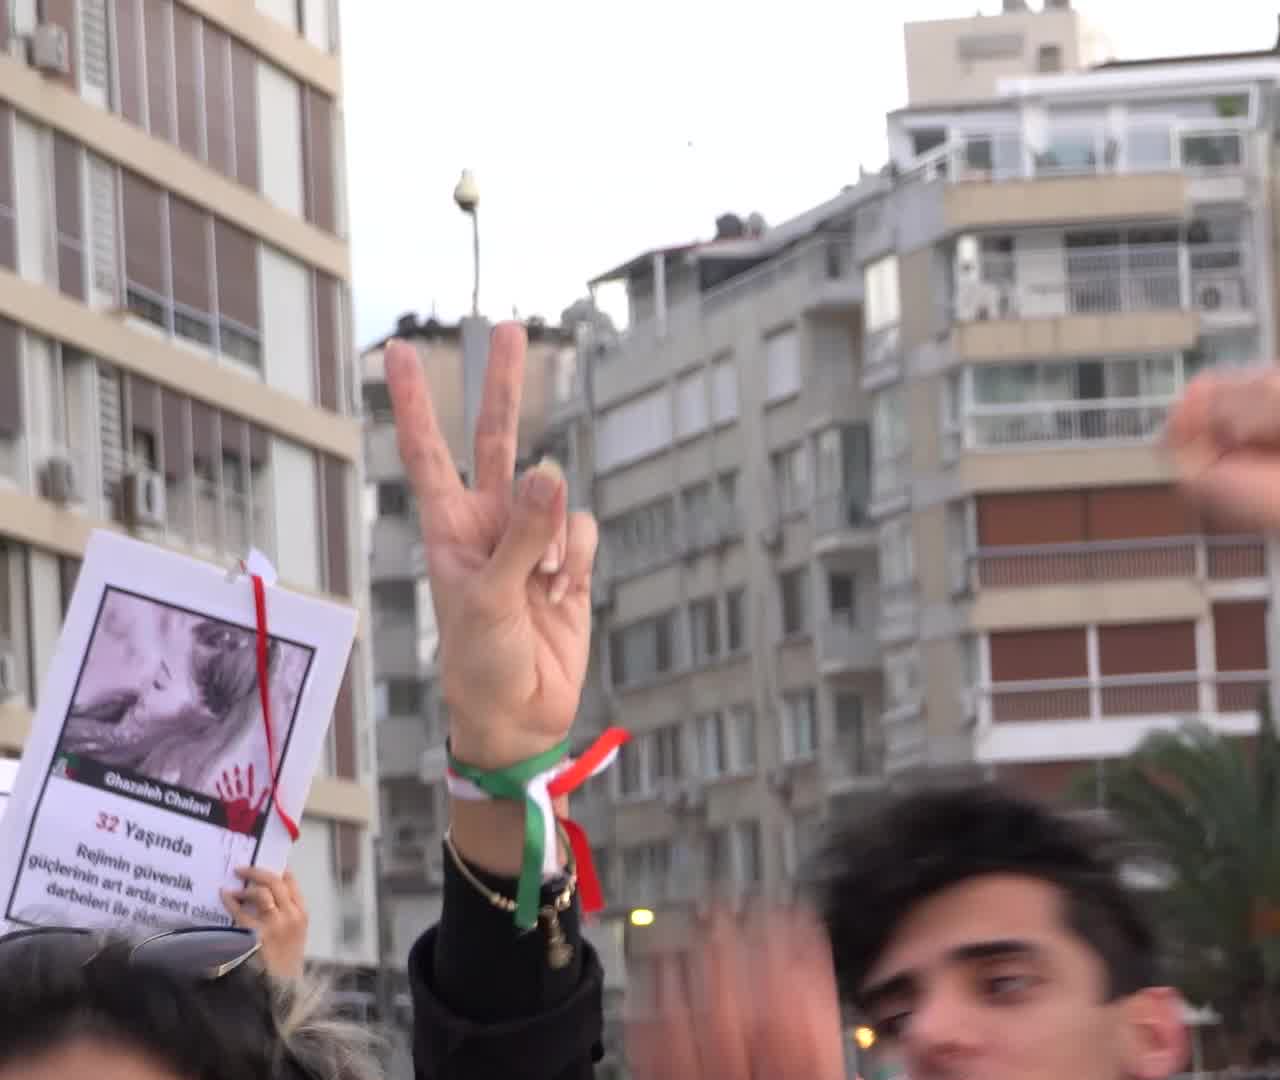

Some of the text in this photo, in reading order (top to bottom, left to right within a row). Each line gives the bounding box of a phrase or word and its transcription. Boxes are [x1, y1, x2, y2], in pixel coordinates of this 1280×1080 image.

[103, 771, 162, 801] Ghazaleh
[96, 811, 193, 857] 32 Yaşında
[77, 842, 193, 893] Rejimin güvenlik
[46, 882, 109, 913] darbeleri
[112, 899, 130, 917] ile
[102, 875, 123, 893] art
[126, 884, 156, 905] arda
[159, 894, 188, 914] sert
